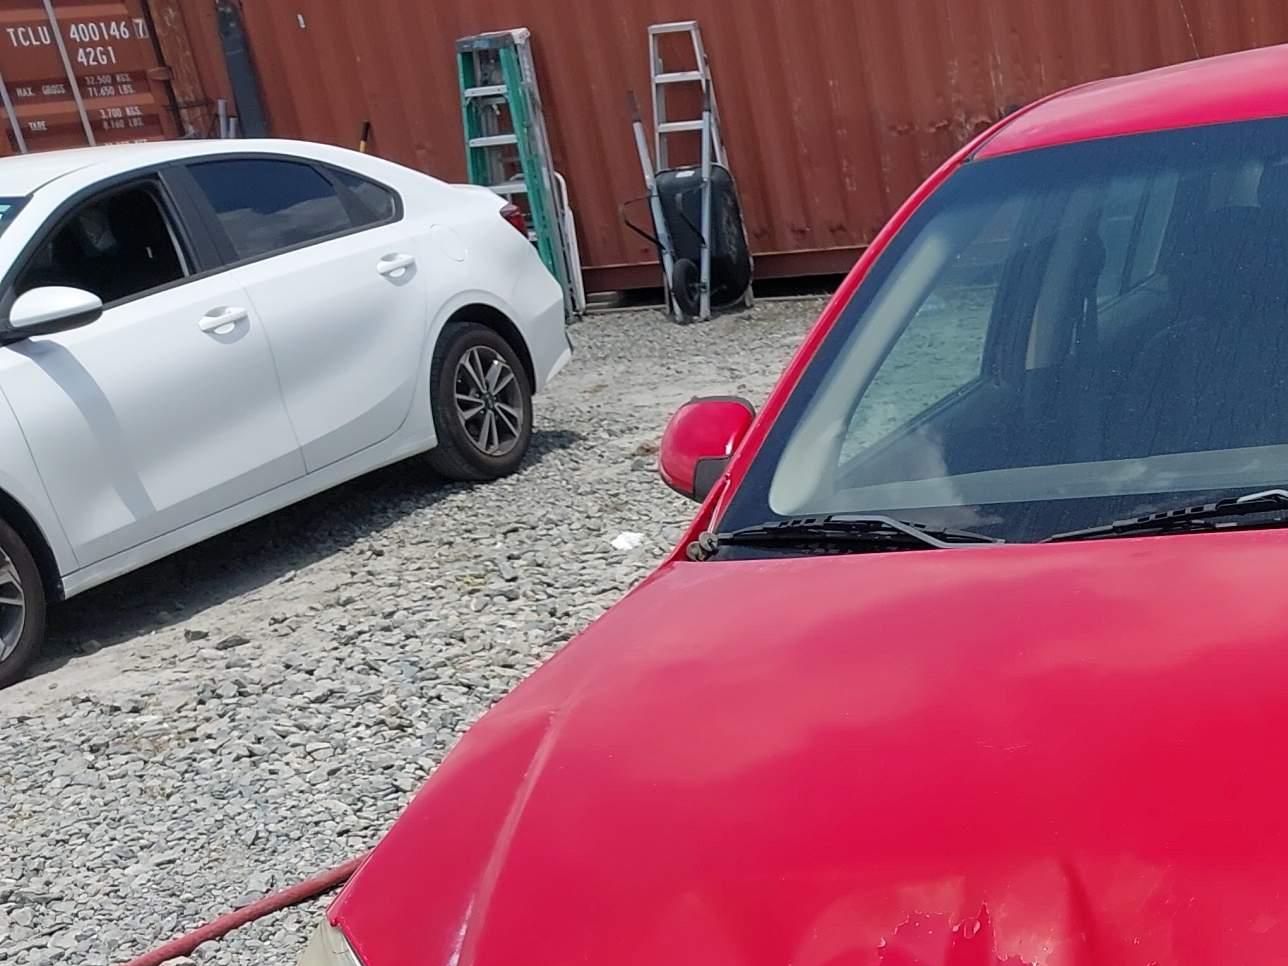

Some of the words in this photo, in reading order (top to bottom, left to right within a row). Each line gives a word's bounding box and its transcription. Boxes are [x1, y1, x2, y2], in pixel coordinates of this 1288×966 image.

[6, 26, 50, 47] TCLU
[69, 21, 129, 42] 400146
[77, 46, 117, 66] 42G1
